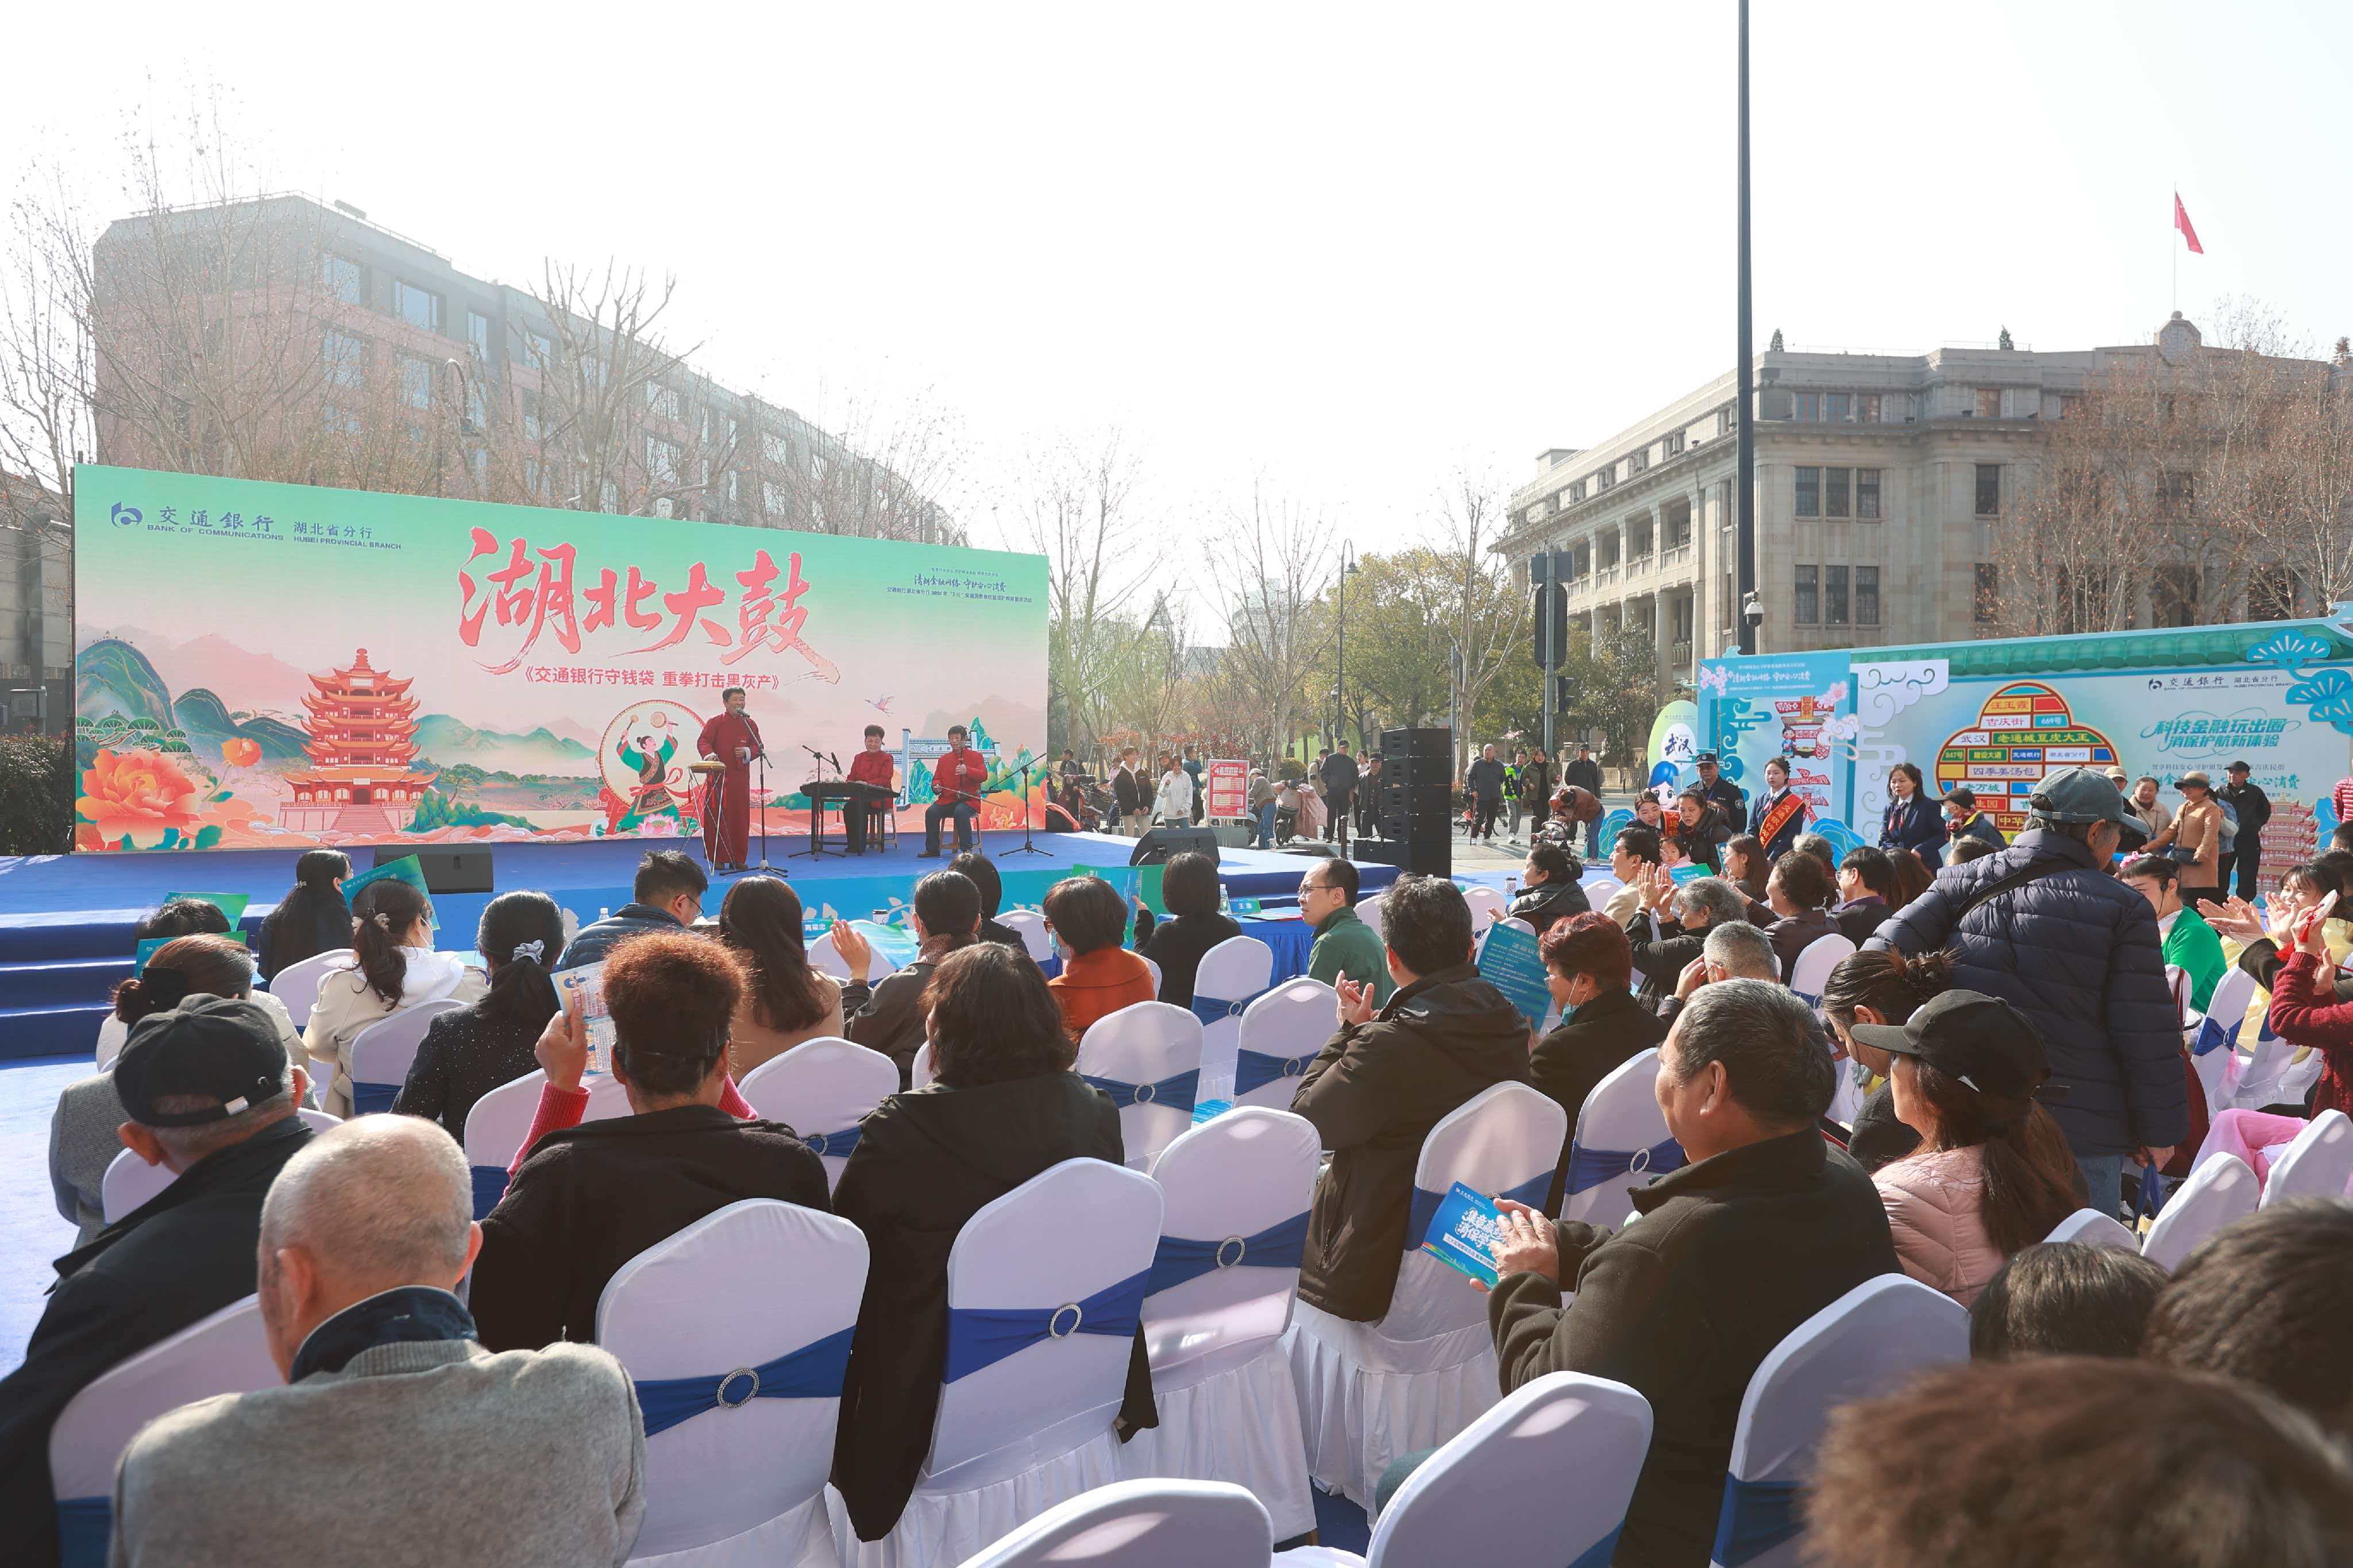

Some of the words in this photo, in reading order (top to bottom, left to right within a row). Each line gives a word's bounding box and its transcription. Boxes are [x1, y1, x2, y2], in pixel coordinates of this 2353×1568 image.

[159, 506, 274, 533] 交通銀行
[147, 524, 175, 533] BANK
[199, 528, 284, 541] COMMUNICATIONS
[294, 522, 373, 539] 湖北省分行
[294, 536, 319, 544] HUBEI
[320, 537, 367, 548] PROVINCIAL
[369, 542, 402, 550] BRANCH
[458, 526, 841, 685] 湖北大鼓
[524, 666, 655, 687] 《交通银行守钱袋
[662, 671, 780, 690] 重拳打击黑灰产》
[2234, 675, 2278, 683] 湖北省分行
[1986, 718, 2024, 727] 吉庆街
[2154, 718, 2288, 736] 科技金融玩出圈
[1665, 733, 1693, 756] 武汉
[1961, 735, 1986, 743] 武汉
[1997, 732, 2090, 743] 老通城豆皮大王
[2169, 735, 2279, 748] 消保护航新体验
[1973, 767, 2035, 776] 四季美汤包
